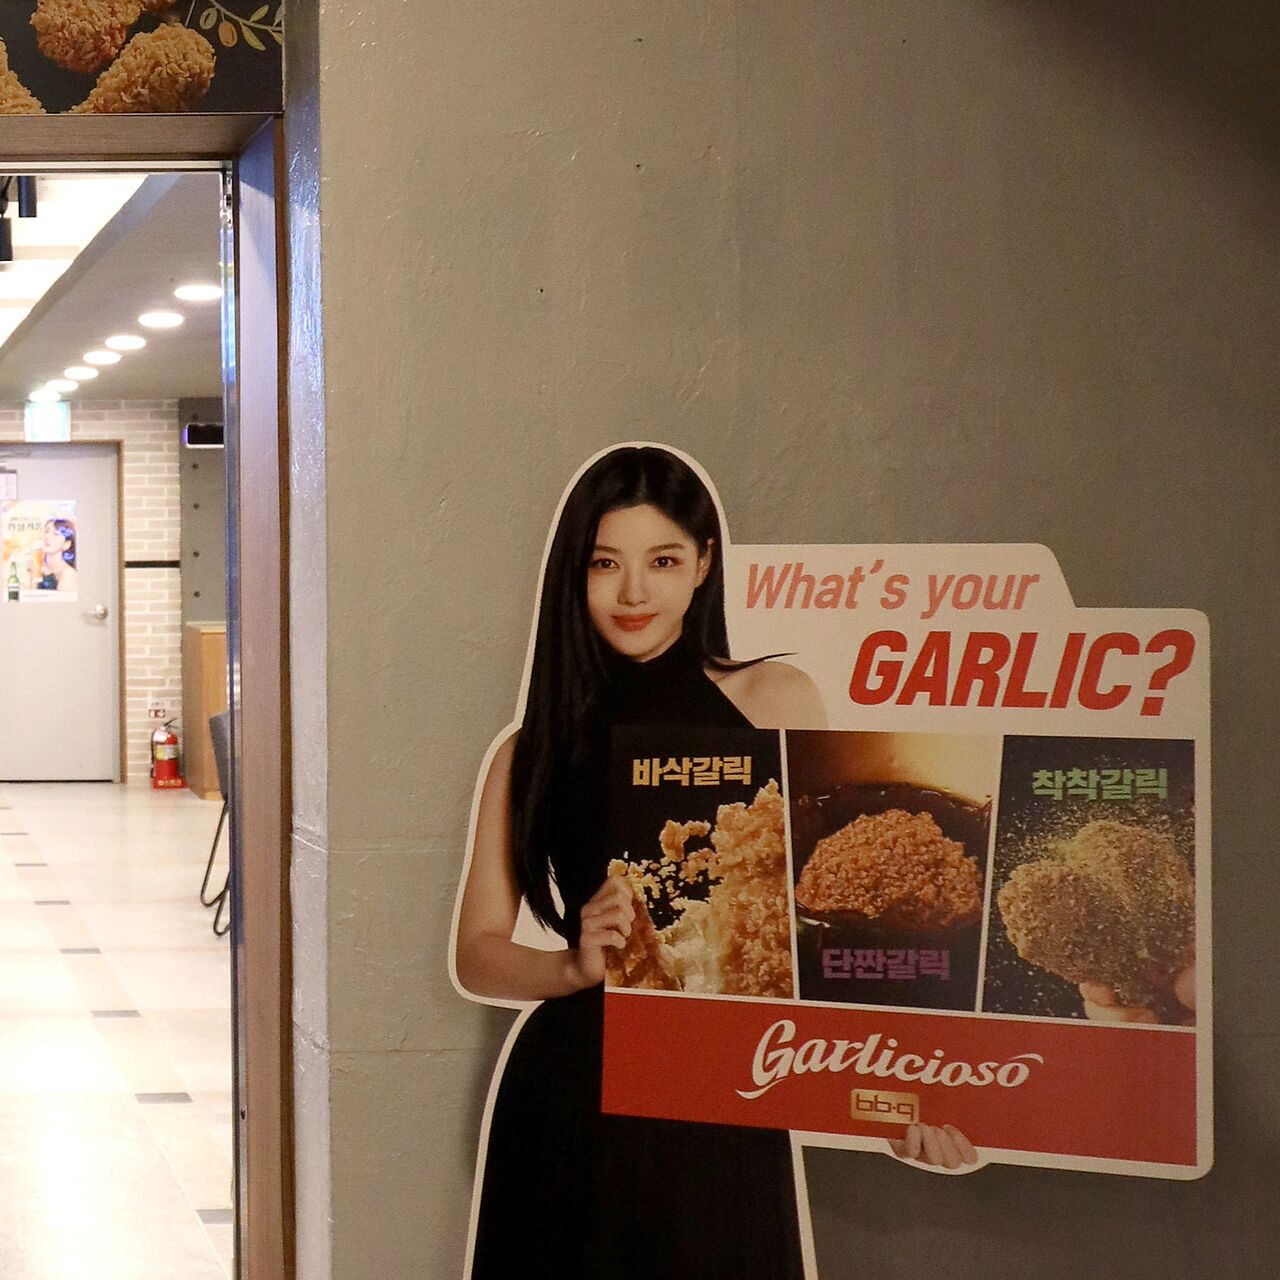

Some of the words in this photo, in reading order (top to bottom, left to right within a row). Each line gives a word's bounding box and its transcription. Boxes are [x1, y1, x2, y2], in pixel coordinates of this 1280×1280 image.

[920, 573, 1041, 620] your
[848, 628, 1196, 717] GARLIC?
[632, 756, 753, 787] 바삭갈릭
[1032, 767, 1169, 801] 착착갈릭
[821, 948, 951, 981] 단짠갈릭
[735, 1018, 1045, 1101] Garlicioso
